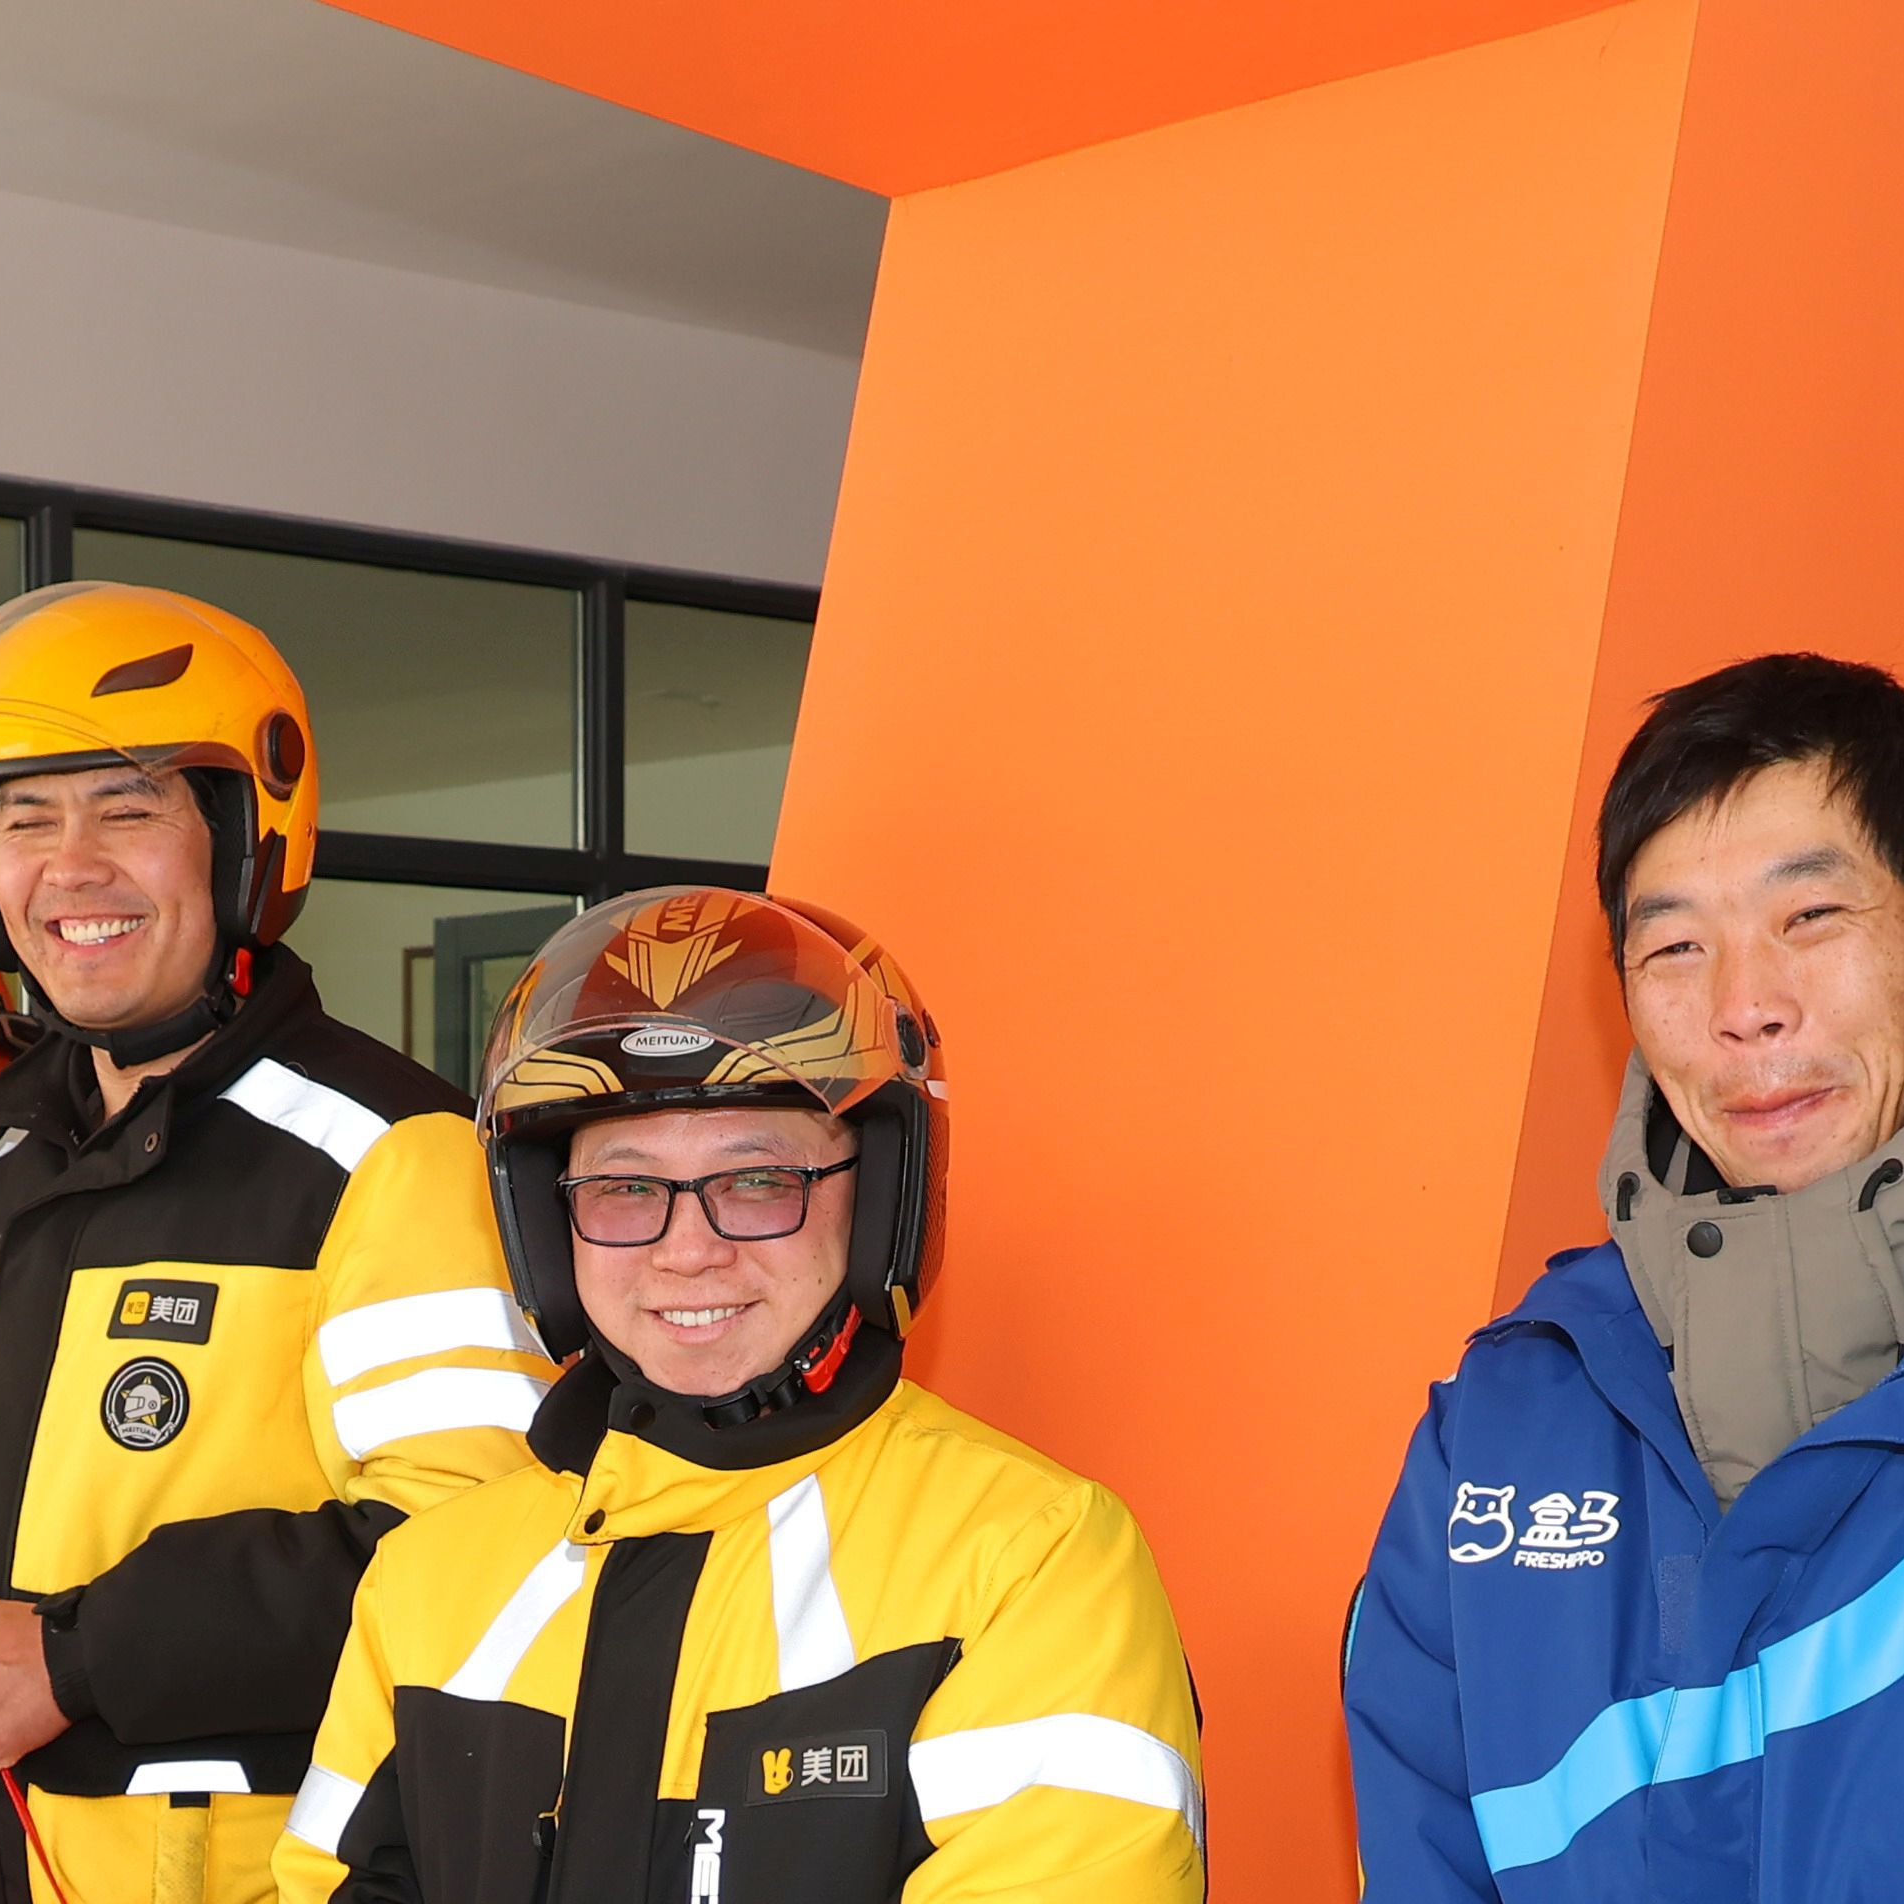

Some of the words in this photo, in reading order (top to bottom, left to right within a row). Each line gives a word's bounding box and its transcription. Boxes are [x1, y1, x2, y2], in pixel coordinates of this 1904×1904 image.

[635, 1035, 701, 1047] MEITUAN
[149, 1295, 201, 1326] 美团
[1518, 1490, 1621, 1549] 盒马
[1513, 1550, 1605, 1570] FRESHIPPO
[800, 1744, 869, 1787] 美团
